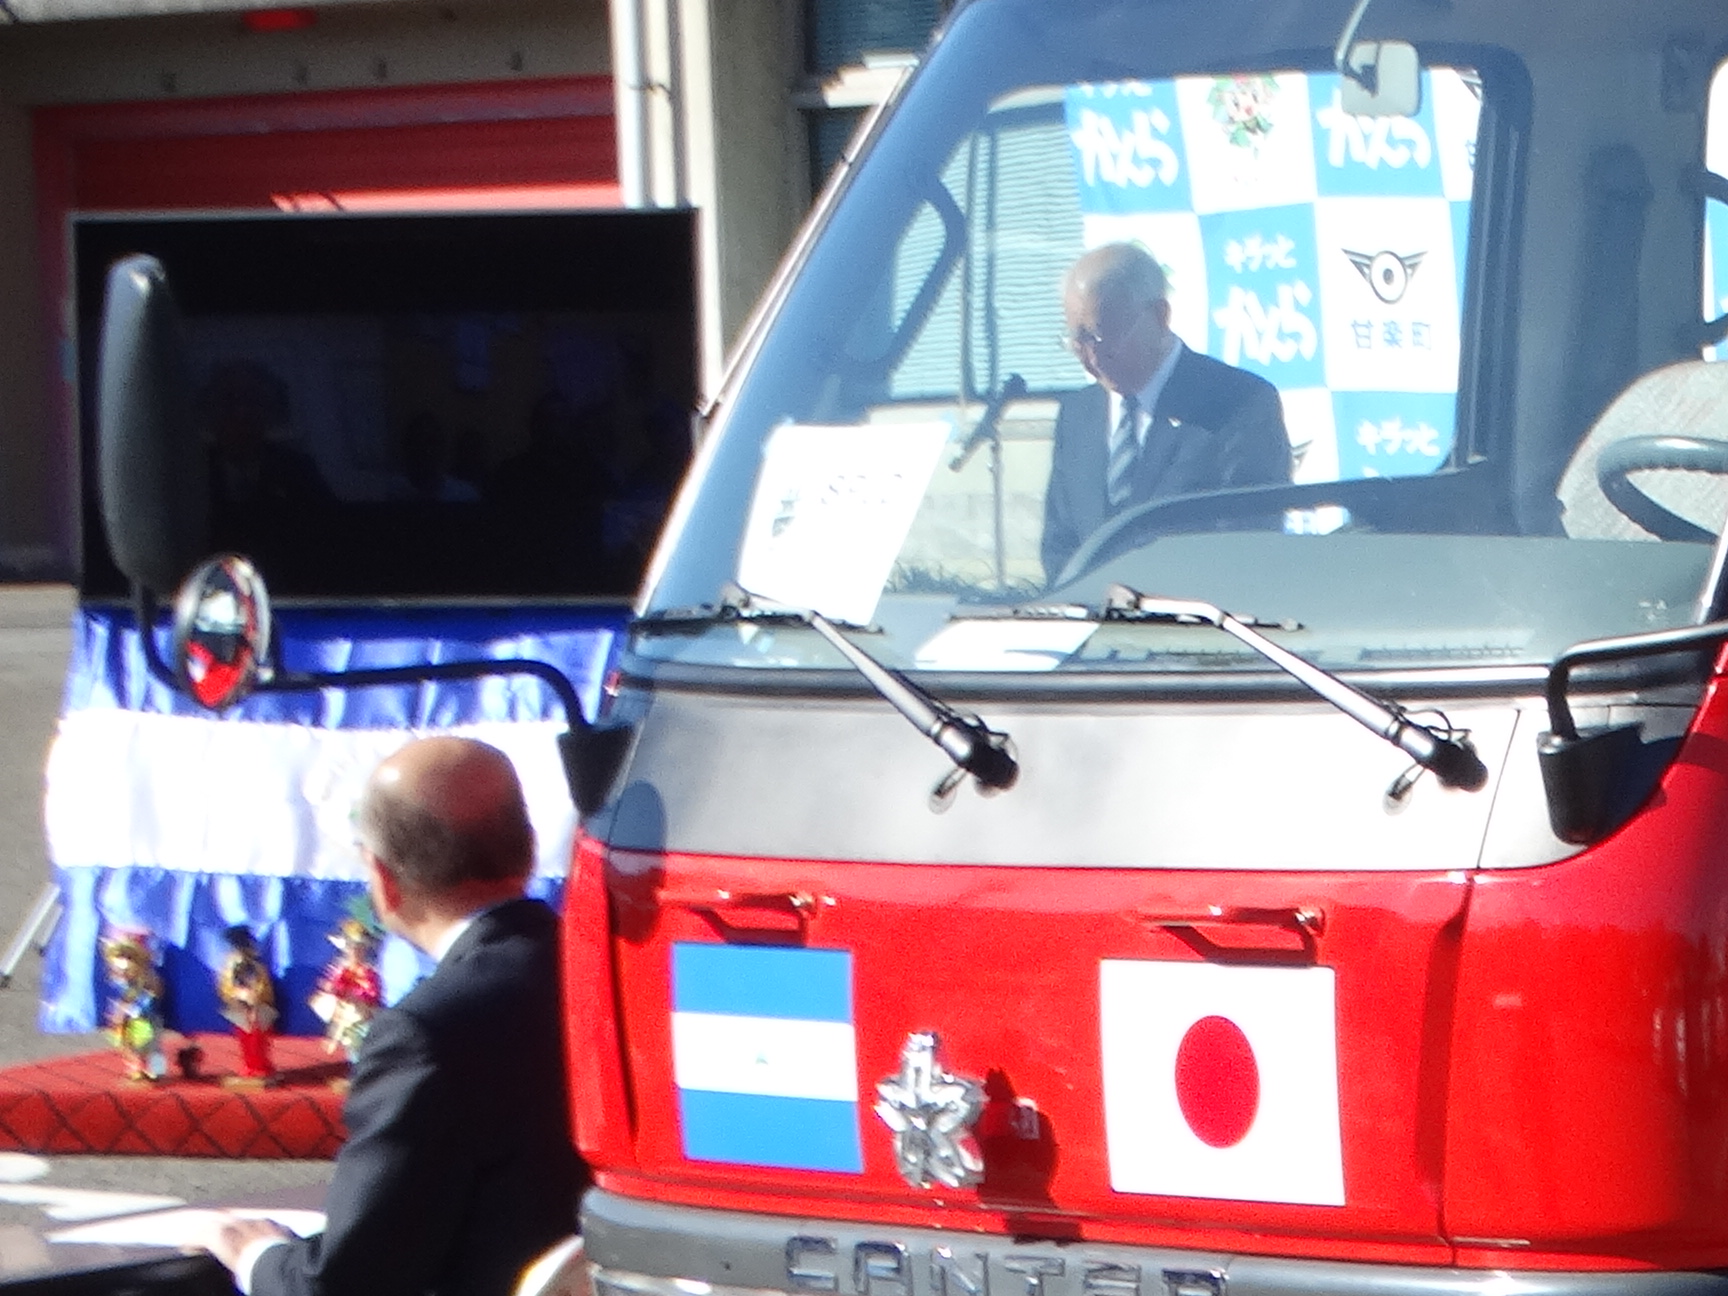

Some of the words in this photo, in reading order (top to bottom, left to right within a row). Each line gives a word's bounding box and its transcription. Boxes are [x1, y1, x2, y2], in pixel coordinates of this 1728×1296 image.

[1071, 106, 1180, 188] かんら
[1213, 280, 1318, 367] かんら
[1350, 318, 1433, 351] 甘楽町
